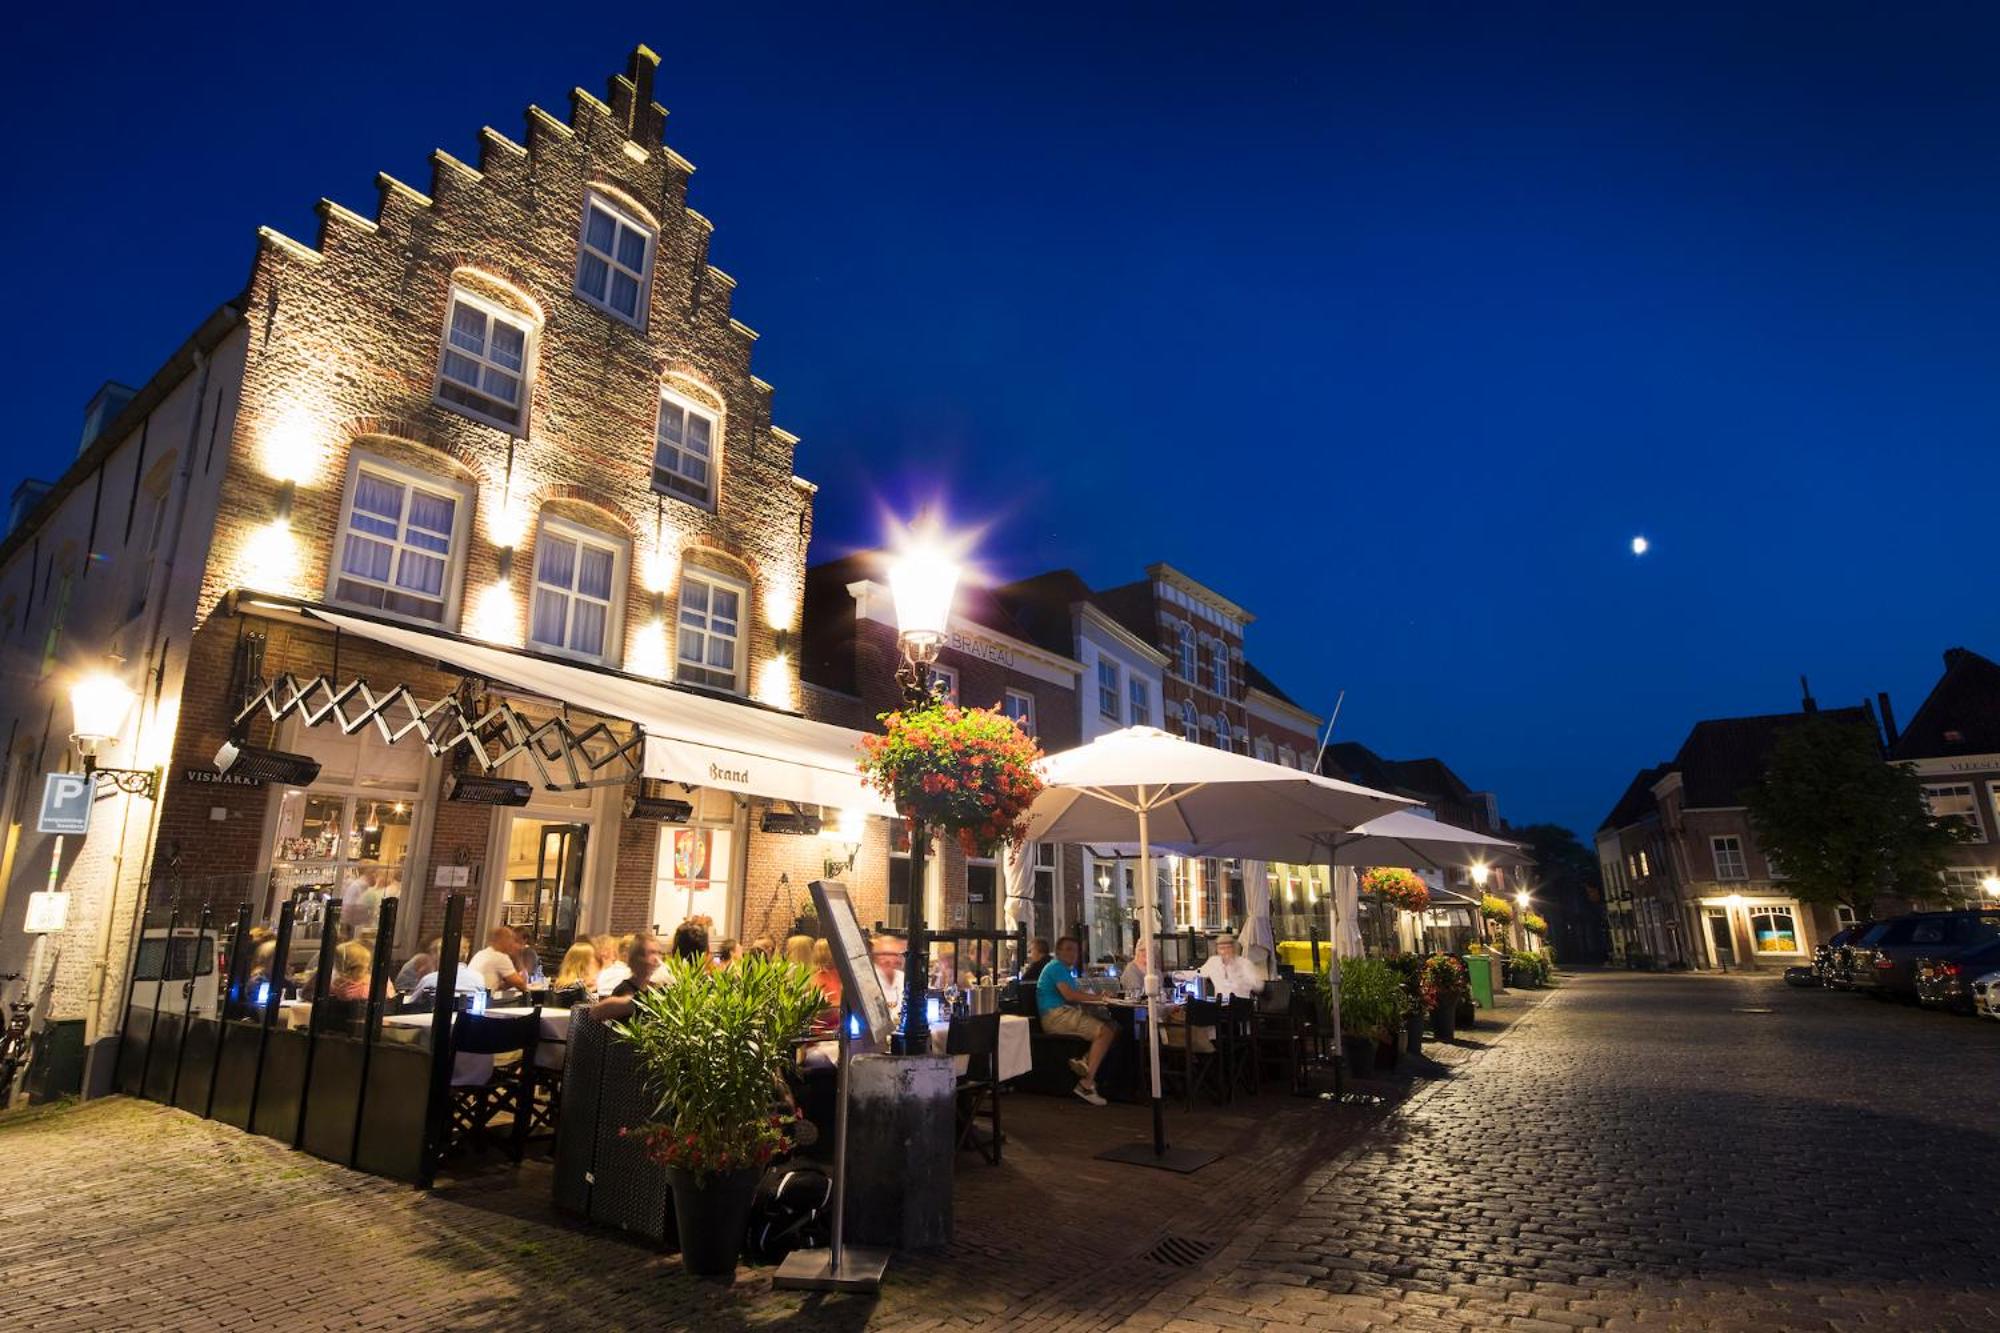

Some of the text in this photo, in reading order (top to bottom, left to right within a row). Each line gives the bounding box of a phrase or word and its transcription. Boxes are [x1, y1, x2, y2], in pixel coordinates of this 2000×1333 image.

[951, 632, 1014, 667] BRAVEAU
[709, 762, 749, 784] Brand
[53, 779, 84, 809] P
